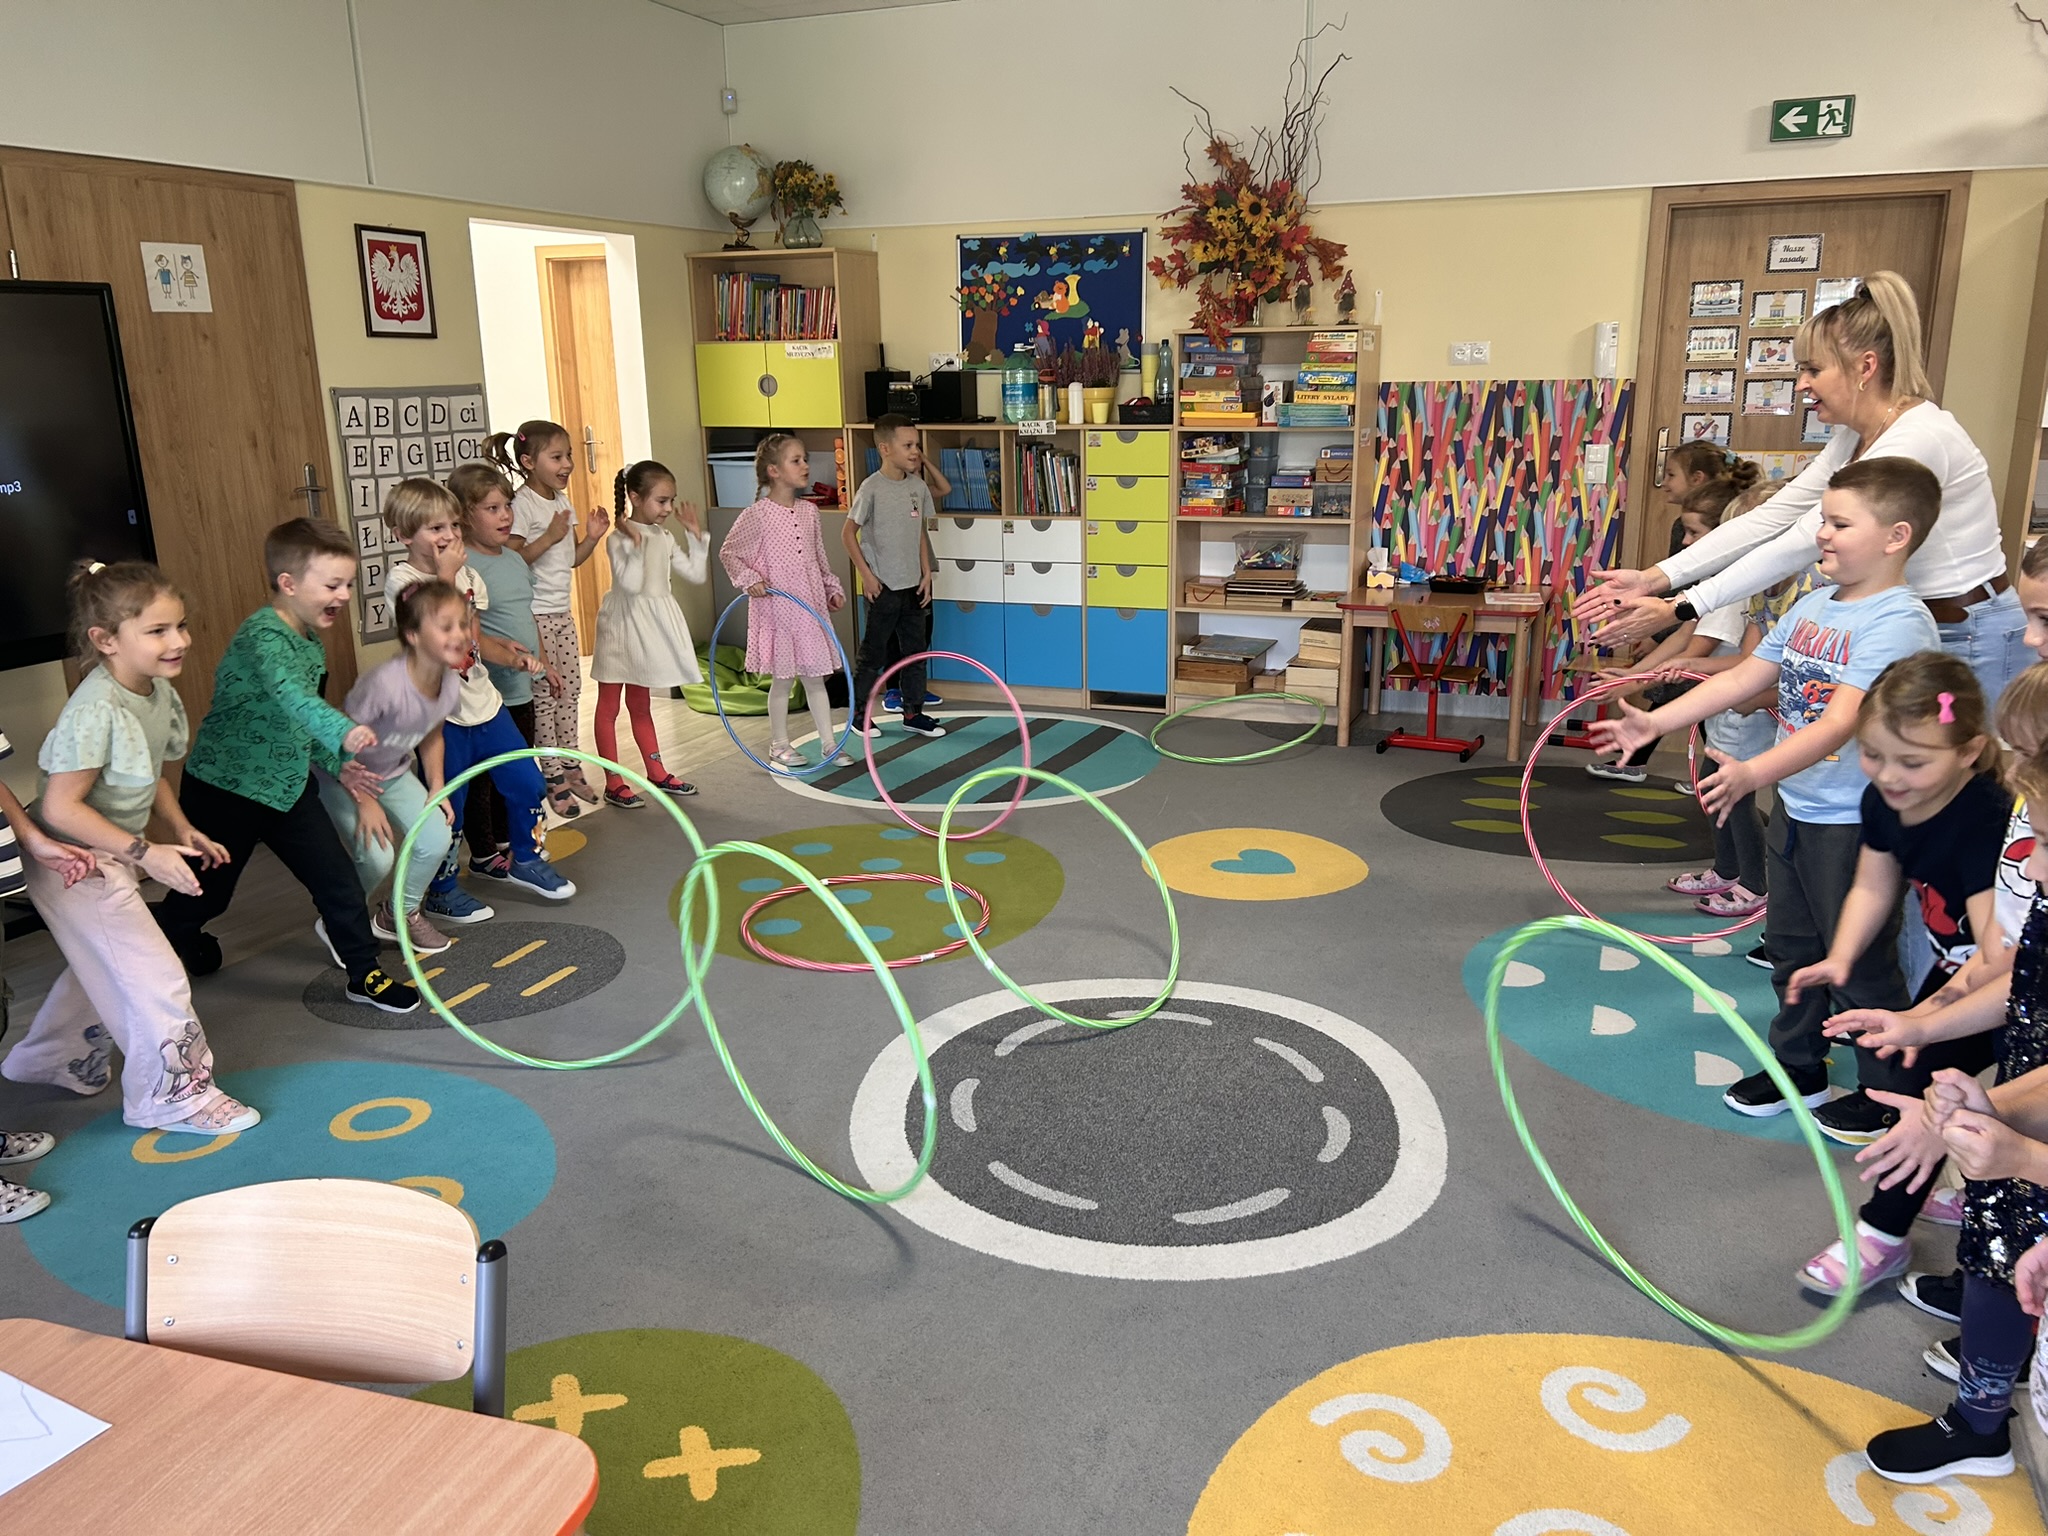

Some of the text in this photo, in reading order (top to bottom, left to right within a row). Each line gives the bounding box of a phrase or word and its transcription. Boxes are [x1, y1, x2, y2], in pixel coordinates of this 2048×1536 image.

[1778, 254, 1809, 265] zasady:
[1782, 244, 1805, 253] Nasze
[176, 299, 188, 308] WC
[345, 402, 478, 428] A B C D ci
[353, 438, 484, 467] E F G H Ch
[361, 486, 369, 507] I
[362, 526, 377, 549] Ł
[367, 564, 381, 587] P
[373, 603, 386, 625] Y
